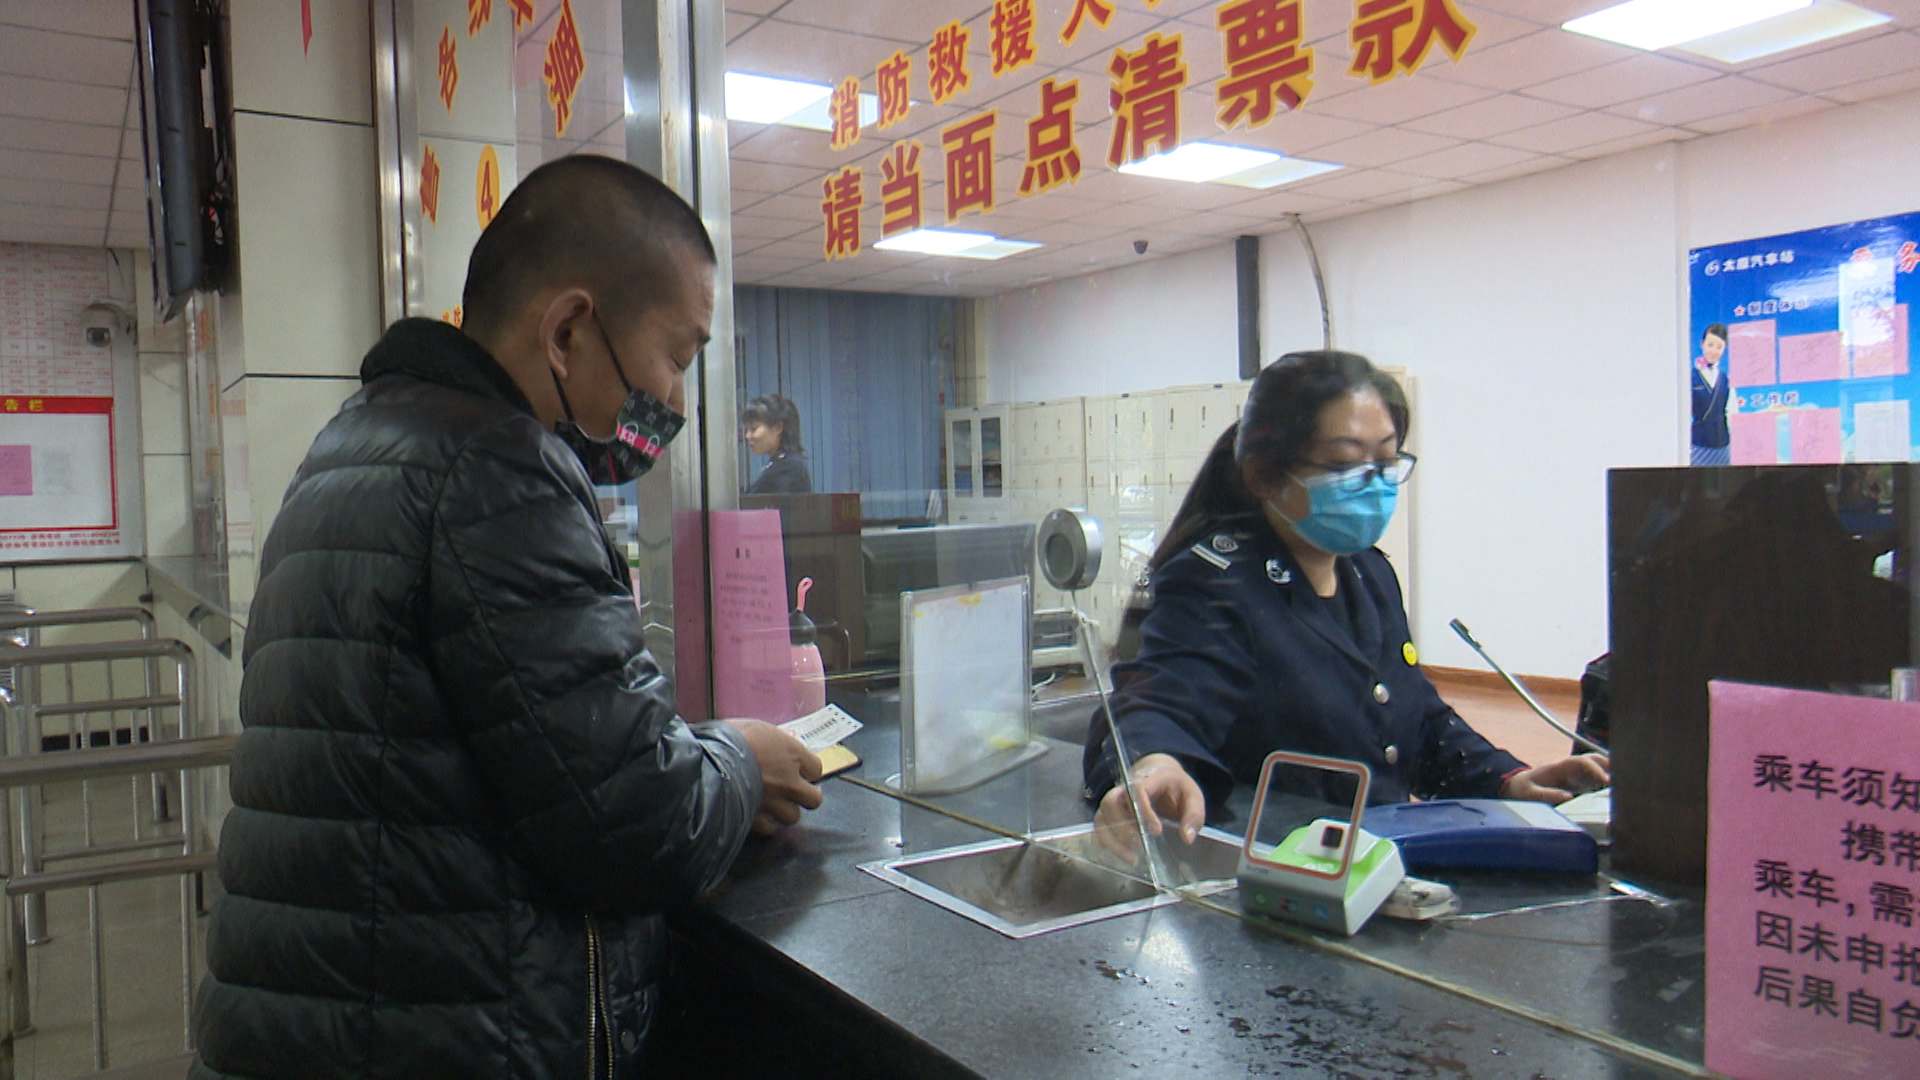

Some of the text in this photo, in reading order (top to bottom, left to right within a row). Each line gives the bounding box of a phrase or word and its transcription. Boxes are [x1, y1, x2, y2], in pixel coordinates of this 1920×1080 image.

[830, 0, 1160, 149] 消防救援人
[822, 0, 1476, 259] 请当面点清票款
[481, 160, 493, 221] 4
[1754, 755, 1920, 813] 乘车须知
[1840, 820, 1920, 872] 携带
[1754, 859, 1920, 927] 乘车，需
[1756, 910, 1920, 985] 因未申报
[1754, 965, 1920, 1039] 后果自负
